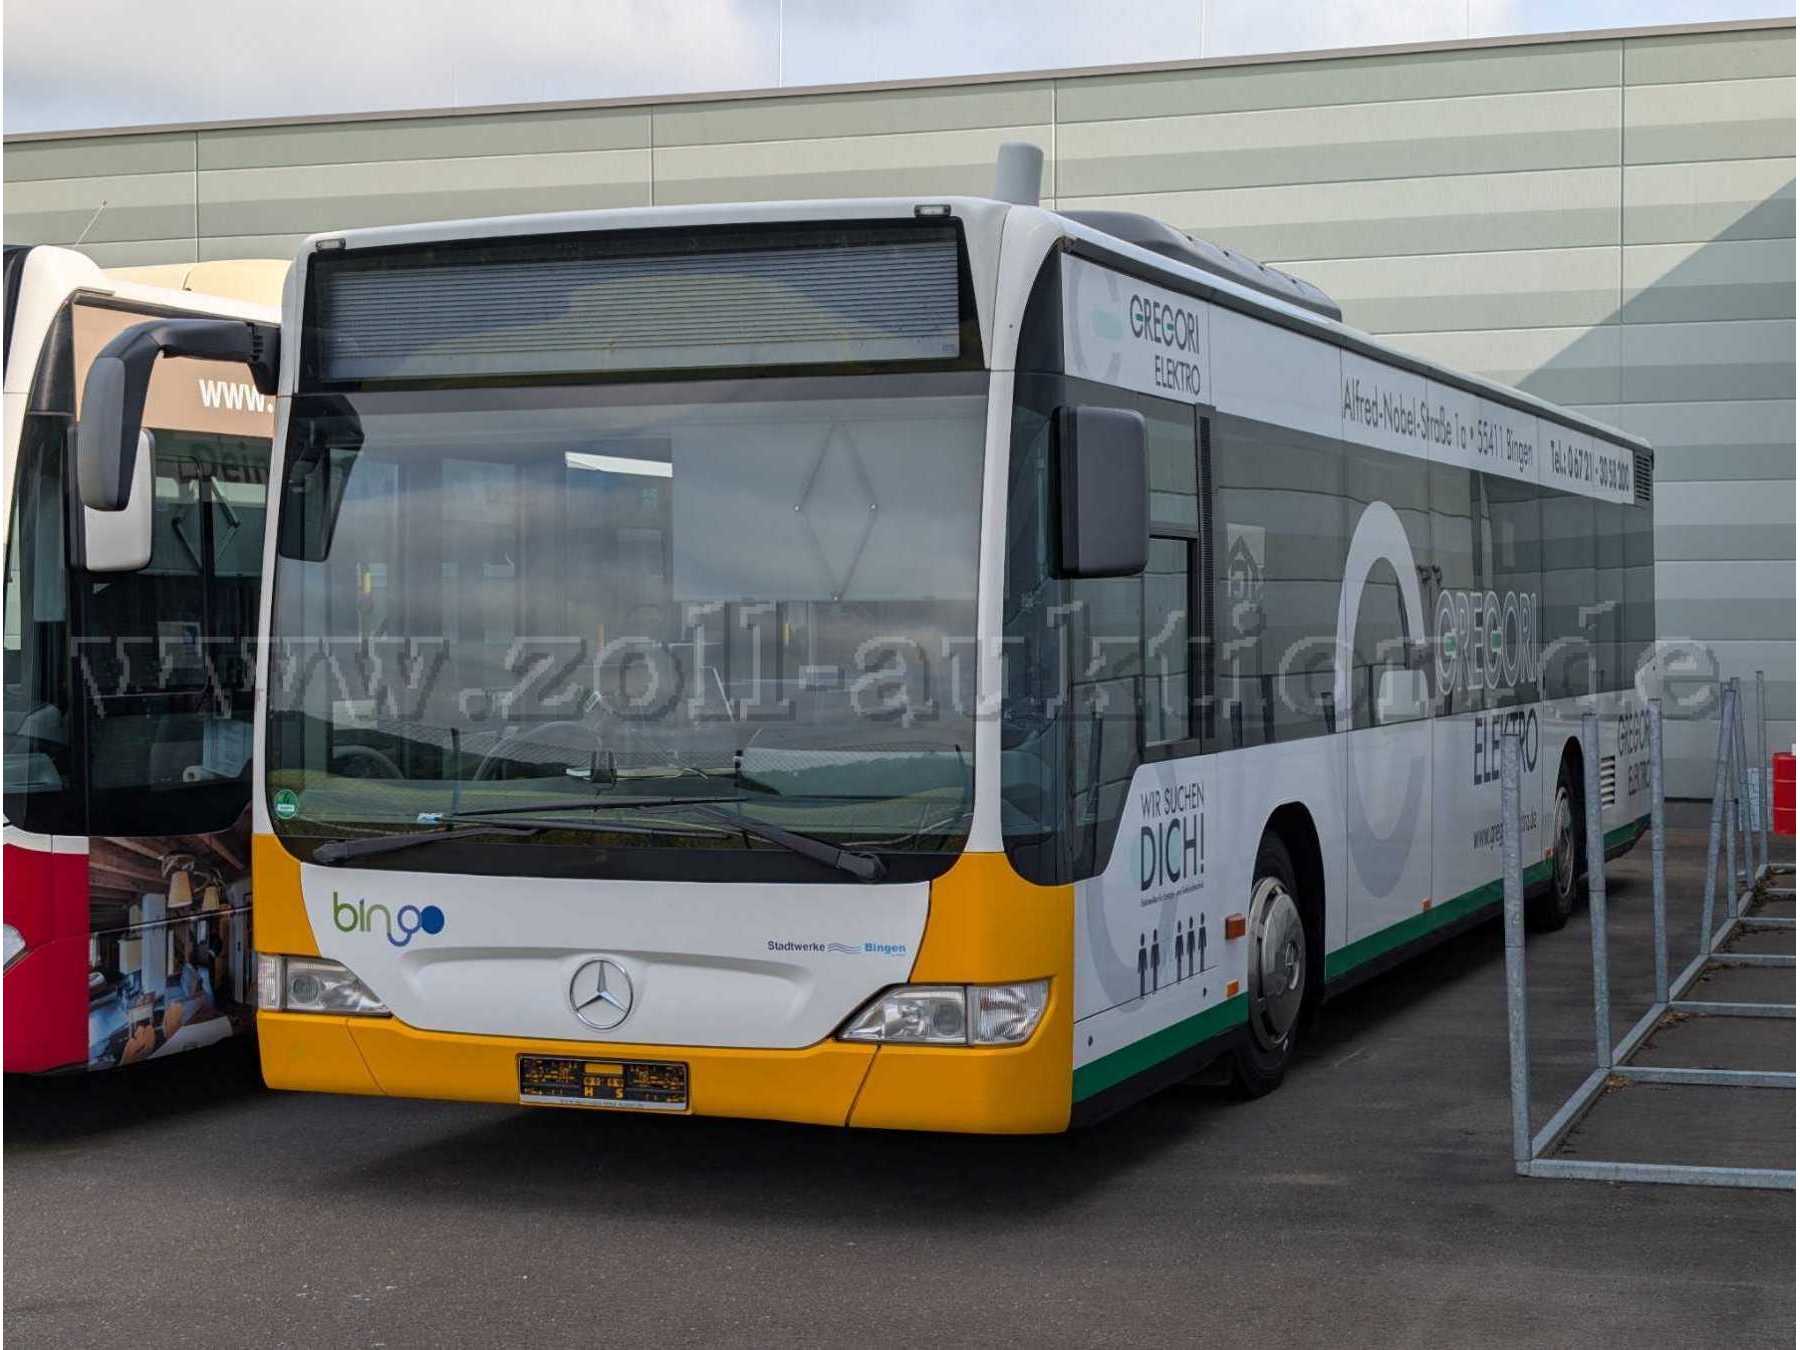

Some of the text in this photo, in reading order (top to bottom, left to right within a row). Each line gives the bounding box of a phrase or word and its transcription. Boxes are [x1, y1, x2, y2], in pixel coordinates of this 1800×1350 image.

[1130, 294, 1200, 354] GREGORI
[199, 379, 274, 414] www.
[1155, 355, 1201, 396] ELEKTRO
[1478, 419, 1502, 459] 55411
[1506, 427, 1533, 472] Bingen
[1435, 589, 1537, 695] GREGORI
[1617, 709, 1651, 756] GREGOR
[1140, 783, 1205, 819] WIR SUCHEN
[1140, 813, 1205, 892] DICH!
[333, 891, 445, 947] bingo
[767, 940, 906, 955] Stadtwerke Bingen
